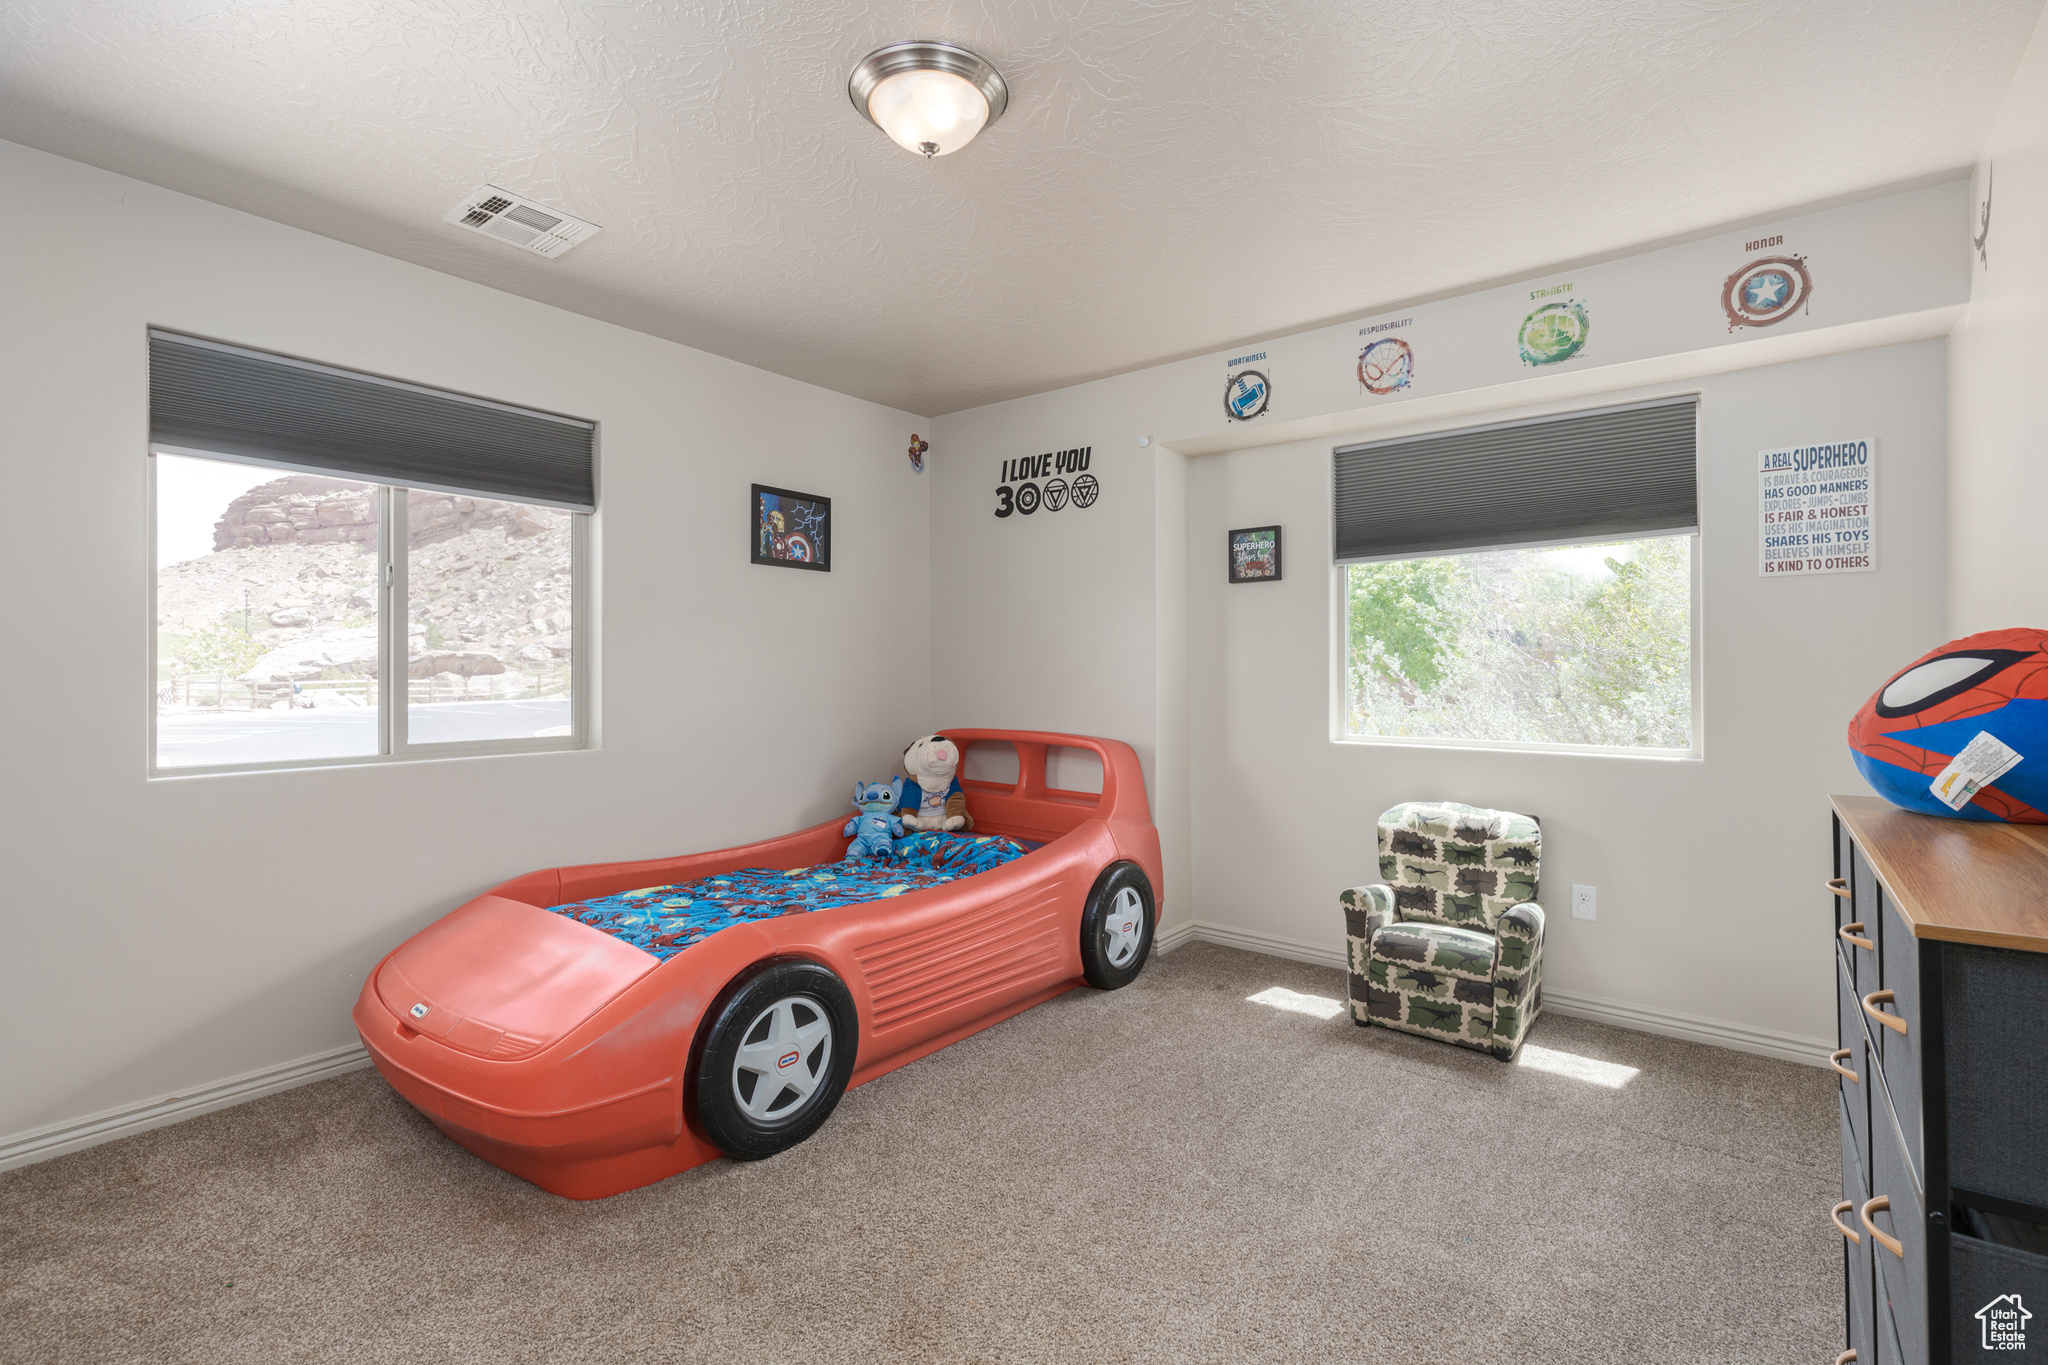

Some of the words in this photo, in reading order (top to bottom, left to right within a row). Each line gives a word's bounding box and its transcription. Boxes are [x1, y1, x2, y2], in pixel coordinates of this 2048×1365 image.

[1745, 235, 1783, 252] HONOR
[1530, 283, 1573, 300] STRENGTH
[1359, 318, 1413, 336] RESPONSIBILITY
[1227, 351, 1267, 367] WORTHINESS
[1001, 460, 1008, 483] I
[1010, 453, 1053, 482] LOVE
[1055, 446, 1092, 475] YOU
[1764, 454, 1770, 469] A
[1772, 452, 1792, 468] REAL
[1793, 441, 1867, 472] SUPERHERO
[1764, 476, 1772, 487] IS
[1773, 473, 1800, 487] BRAVE
[1801, 472, 1809, 484] &
[1811, 466, 1869, 483] COURAGEOUS
[1764, 487, 1784, 499] HAS
[1786, 484, 1817, 497] GOOD
[1819, 479, 1868, 494] MANNERS
[1764, 498, 1802, 512] EXPLORES
[1807, 494, 1833, 508] JUMPS
[1839, 491, 1868, 505] CLIMBS
[1764, 513, 1775, 524] IS
[1778, 510, 1804, 522] FAIR
[1807, 509, 1817, 520] &
[1820, 504, 1868, 519] HONEST
[1765, 523, 1786, 535] USES
[1788, 522, 1803, 534] HIS
[1805, 517, 1869, 532] IMAGINATION
[1233, 540, 1275, 551] SUPERHERO
[1765, 534, 1809, 548] SHARES
[1812, 532, 1832, 544] HIS
[1834, 529, 1869, 542] TOYS
[1765, 546, 1810, 560] BELIEVES
[1812, 545, 1823, 557] IN
[1826, 542, 1870, 556] HIMSELF
[1765, 561, 1775, 573] IS
[1777, 559, 1803, 572] KIND
[1806, 558, 1822, 570] TO
[1825, 555, 1870, 571] OTHERS
